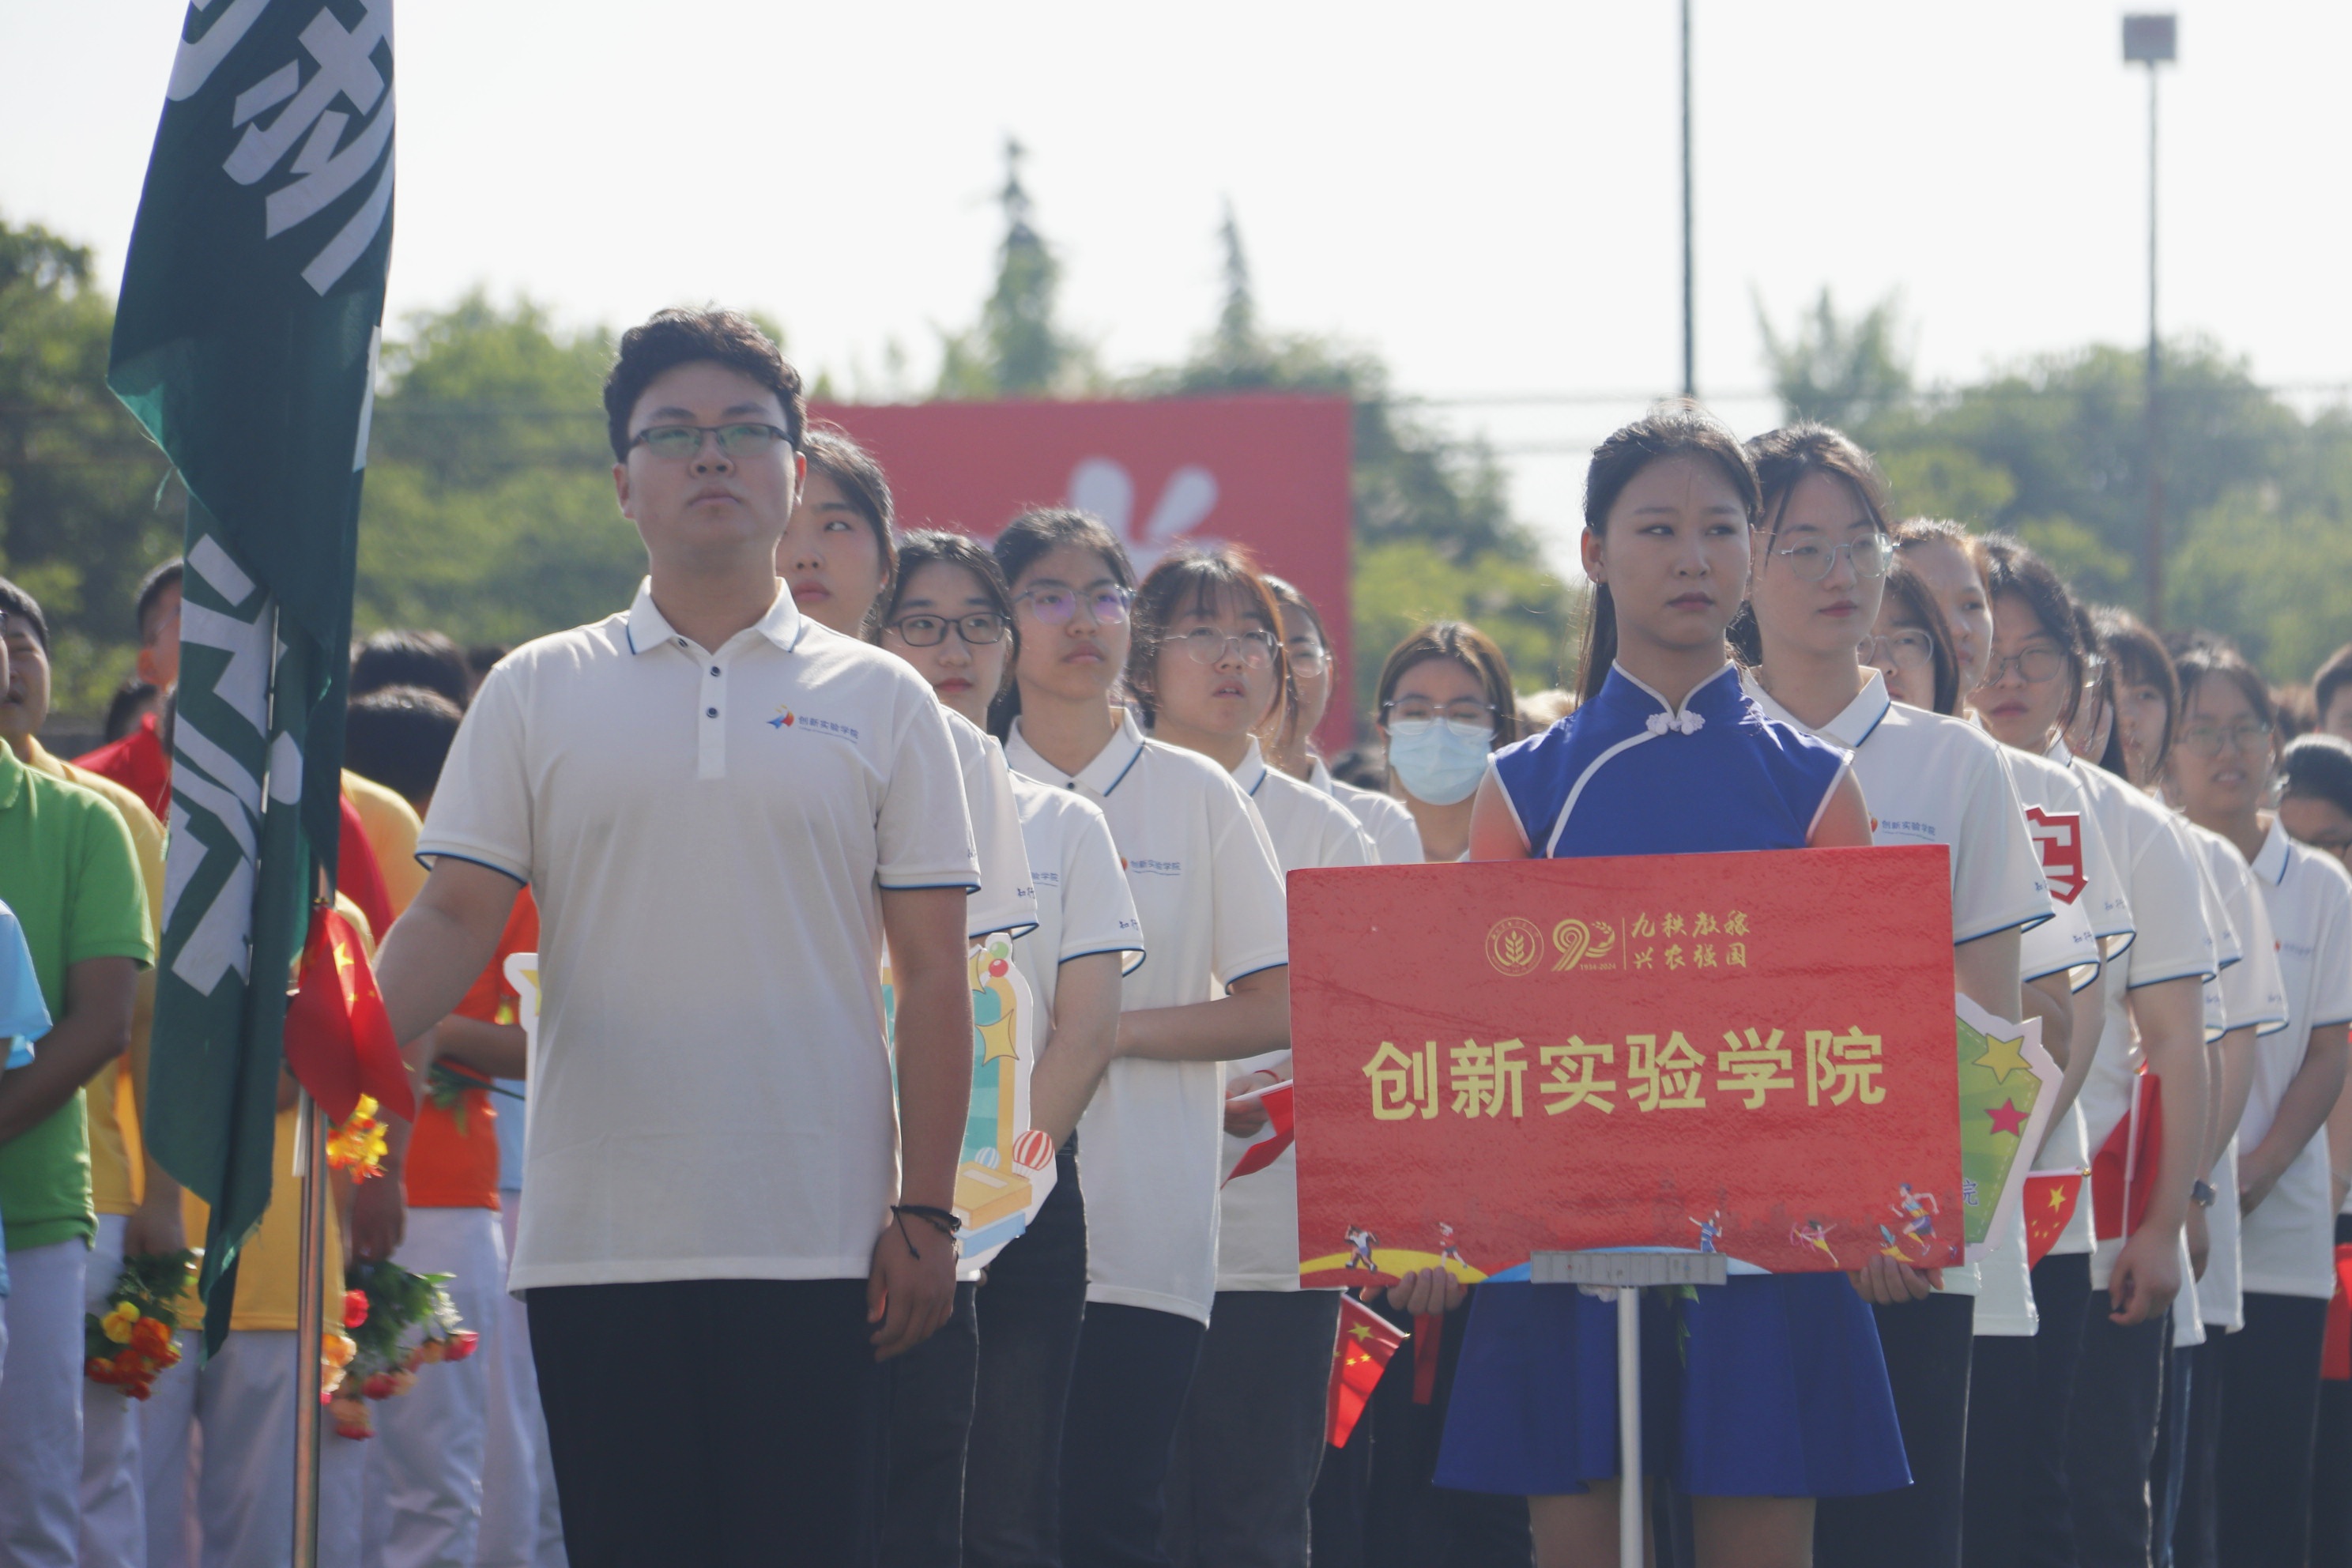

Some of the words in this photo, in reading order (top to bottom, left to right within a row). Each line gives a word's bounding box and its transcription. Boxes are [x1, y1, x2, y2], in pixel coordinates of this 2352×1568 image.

[797, 715, 859, 739] 创新实验学院
[1882, 820, 1936, 836] 创新实验学院
[1632, 941, 1747, 970] 兴农强国
[1363, 1025, 1886, 1121] 创新实验学院
